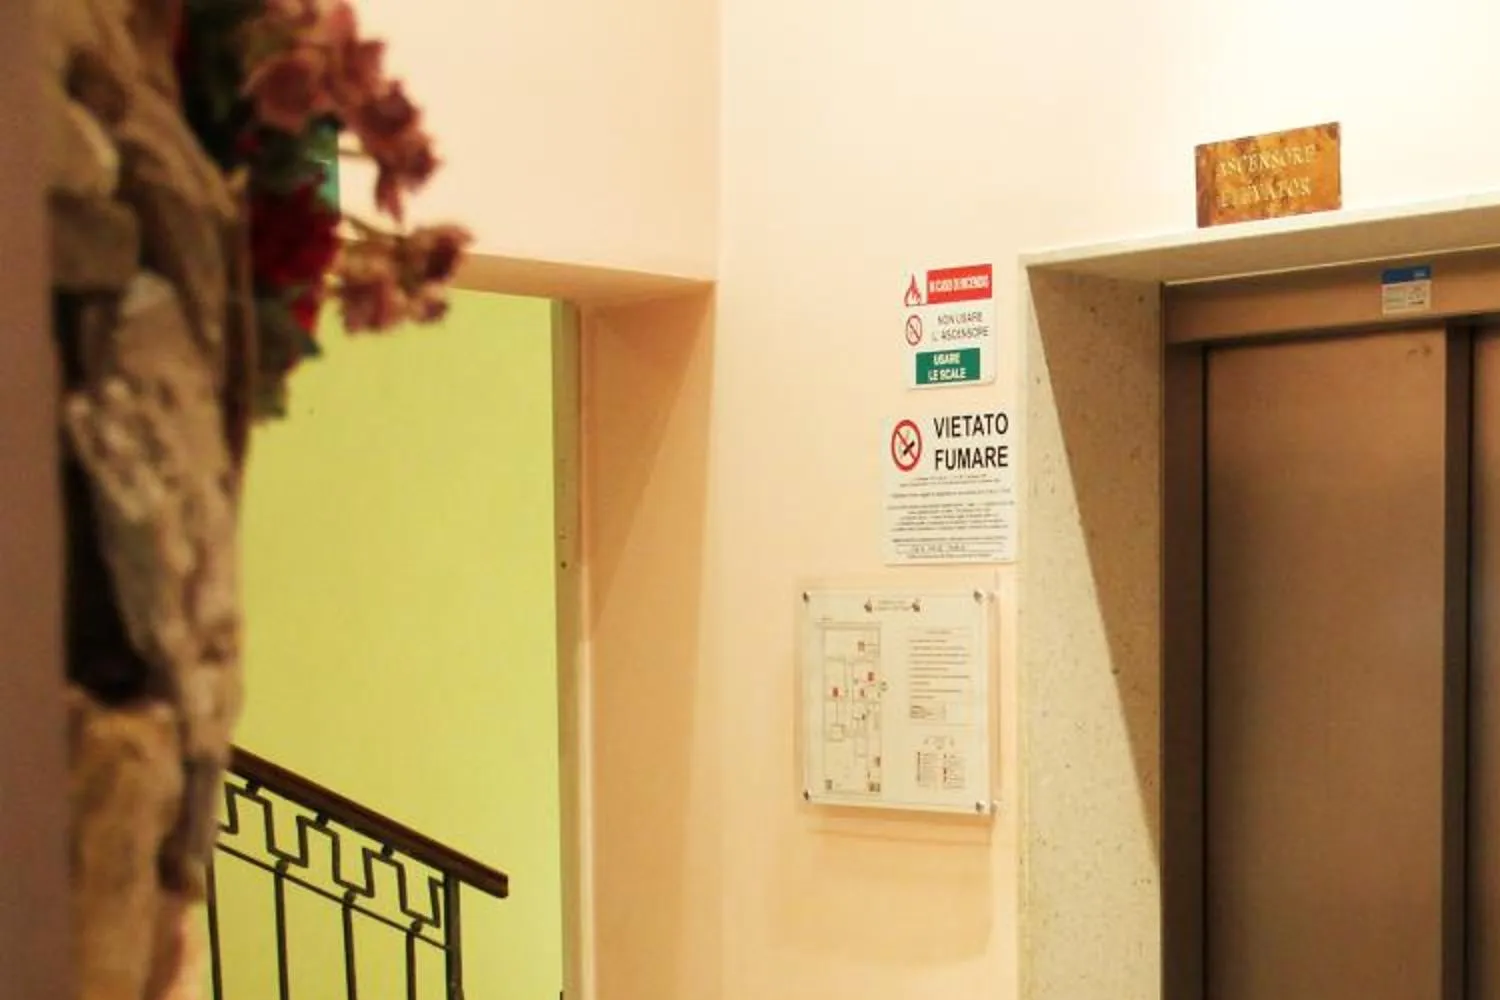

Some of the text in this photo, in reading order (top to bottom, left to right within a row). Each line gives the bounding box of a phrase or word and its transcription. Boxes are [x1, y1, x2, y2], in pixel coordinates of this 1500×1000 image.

[1217, 144, 1318, 178] ASCENSORE
[938, 311, 983, 325] NON USARE
[933, 352, 961, 366] USARE
[927, 366, 968, 381] LE SCALE
[933, 412, 1009, 439] VIETATO
[934, 445, 1009, 471] FUMARE
